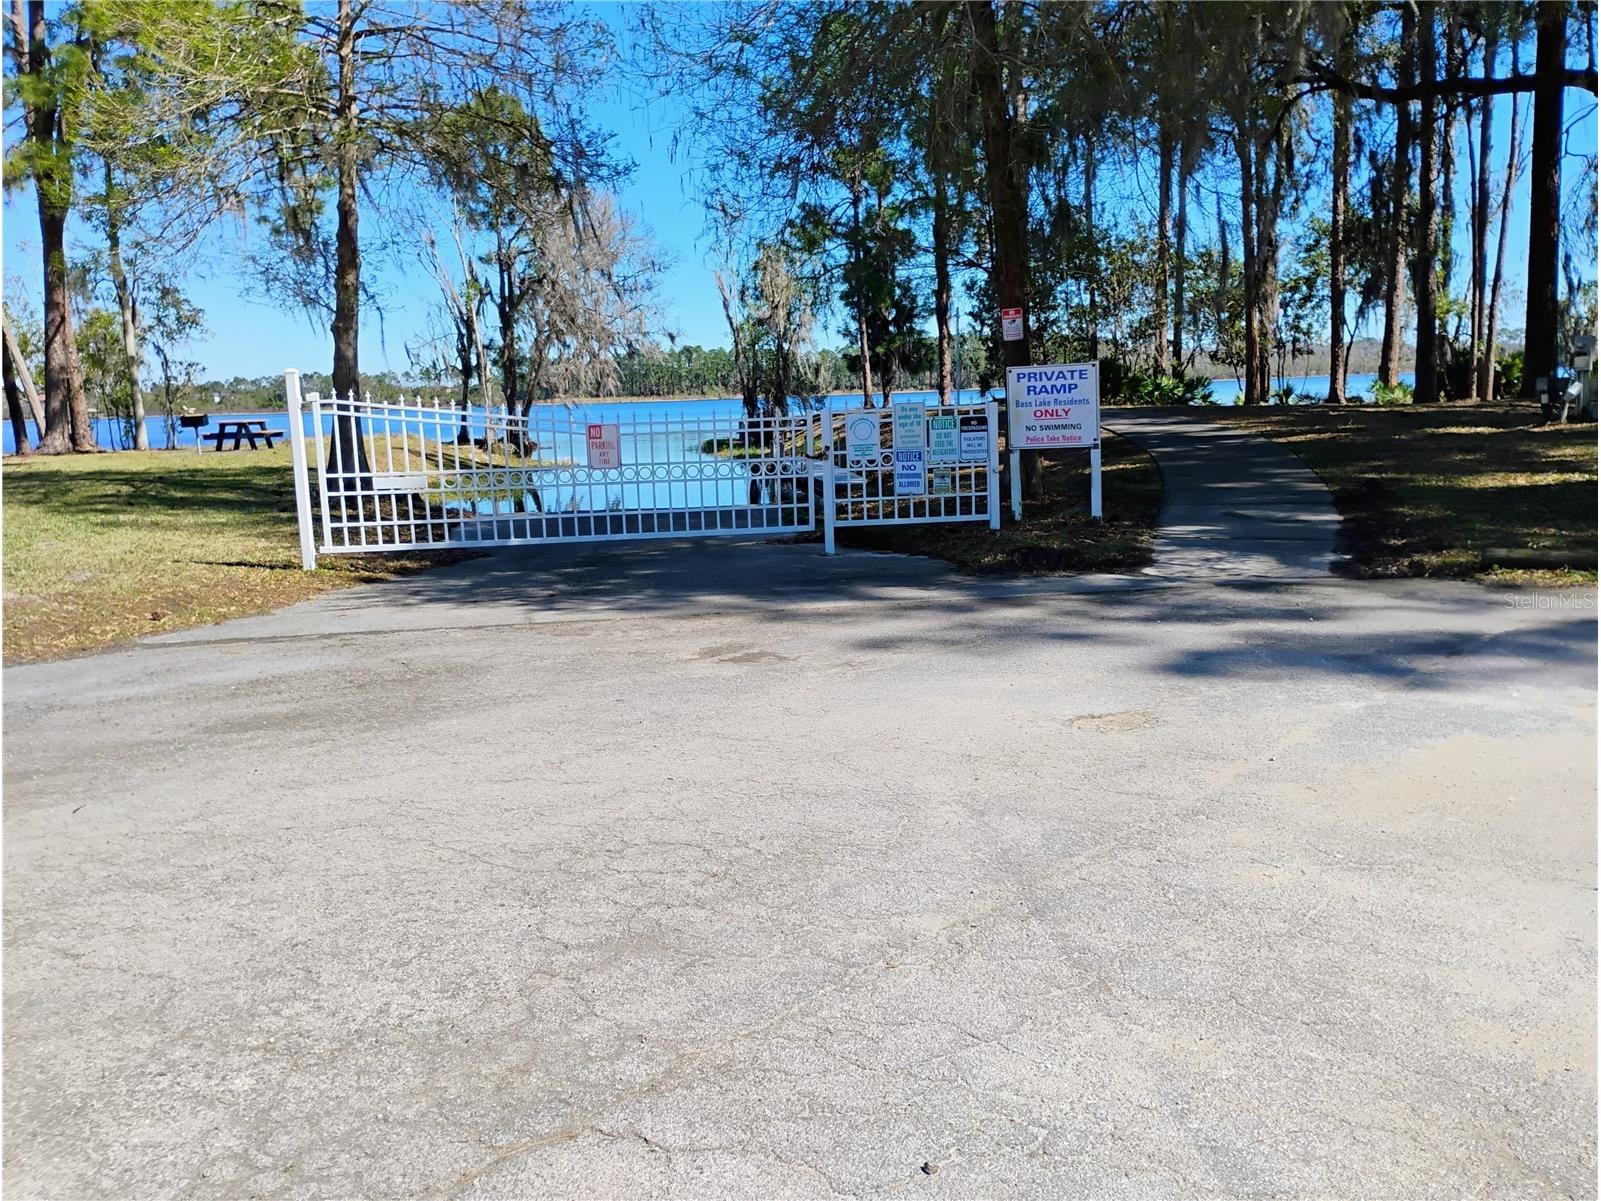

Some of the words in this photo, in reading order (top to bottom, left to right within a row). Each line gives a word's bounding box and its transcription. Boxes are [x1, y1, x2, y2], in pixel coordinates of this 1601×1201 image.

[1016, 369, 1089, 383] PRIVATE
[1027, 383, 1078, 396] RAMP
[1015, 400, 1032, 408] Bass
[1035, 399, 1051, 407] Lake
[1054, 397, 1090, 406] Residents
[1033, 408, 1071, 418] ONLY
[933, 419, 957, 429] NOTICE
[1039, 423, 1082, 431] SWIMMING
[590, 427, 601, 438] NO
[591, 441, 615, 450] PARKING
[897, 451, 921, 461] NOTICE
[901, 464, 916, 472] NO
[896, 472, 922, 480] SWIMMING
[898, 480, 920, 488] ALLOWED
